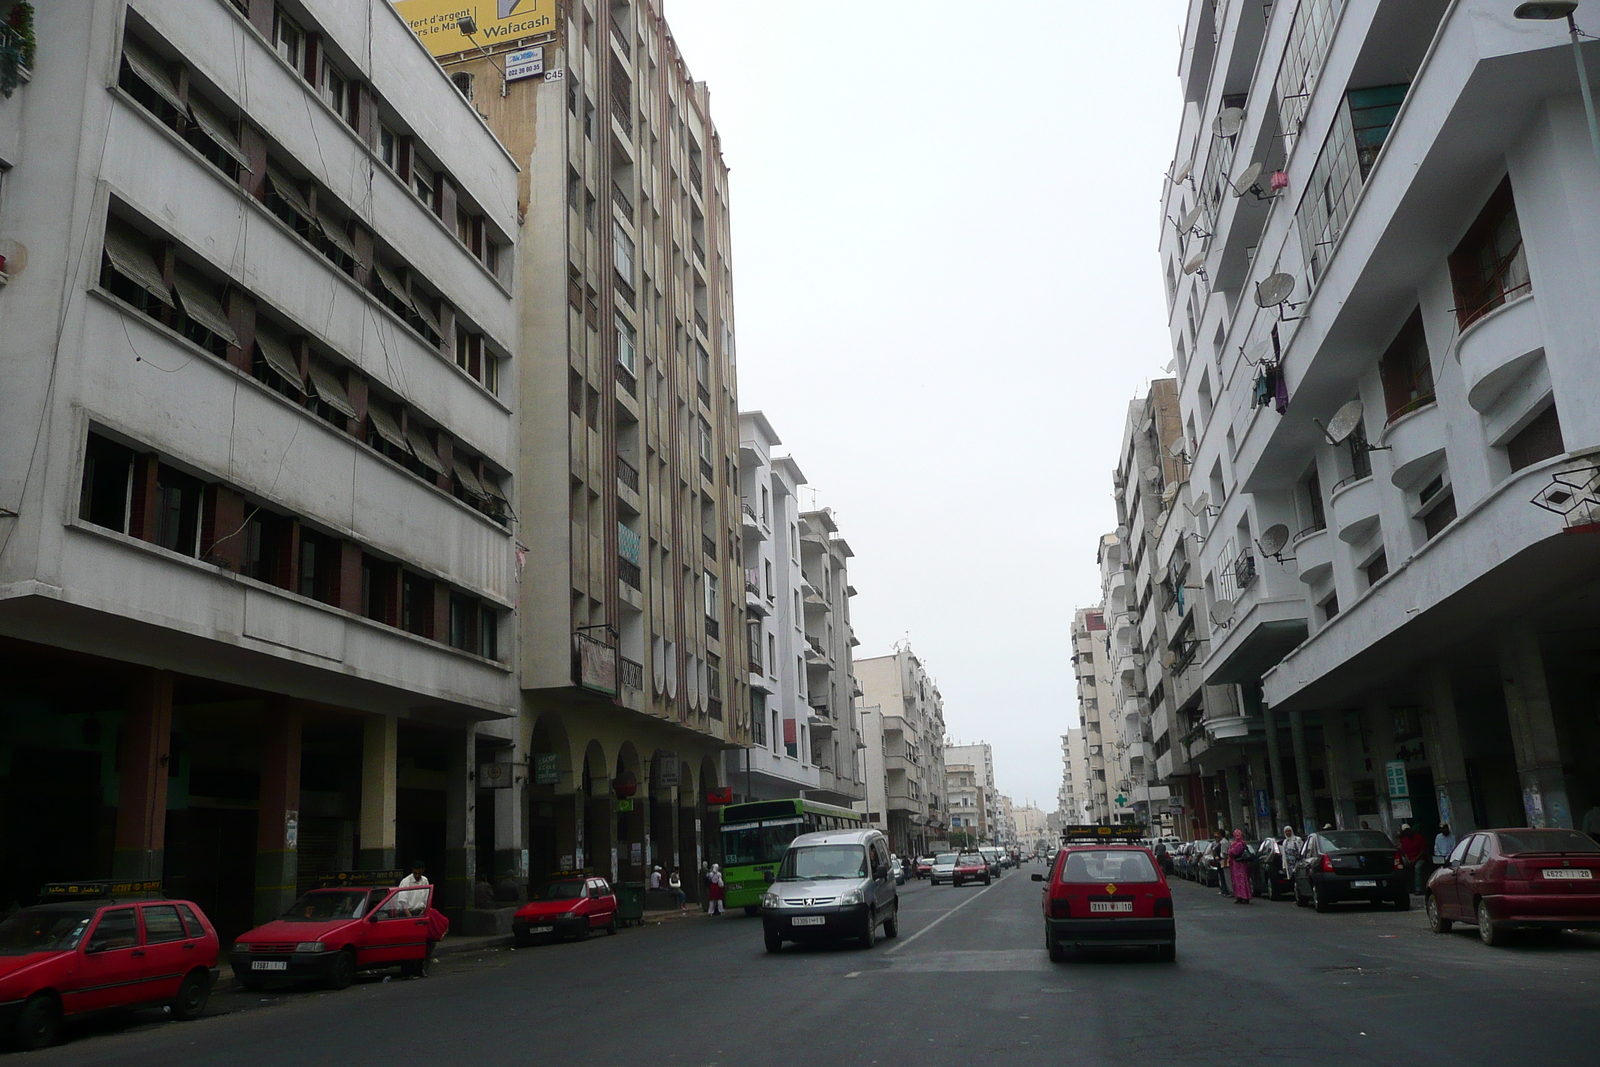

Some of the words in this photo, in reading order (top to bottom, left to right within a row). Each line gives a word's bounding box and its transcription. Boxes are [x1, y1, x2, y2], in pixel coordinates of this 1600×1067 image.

[408, 18, 428, 29] fert
[430, 8, 471, 24] d'argent
[430, 26, 439, 34] le
[441, 22, 460, 32] Mar
[483, 15, 550, 39] Wafacash
[545, 70, 564, 80] C45
[1124, 903, 1132, 911] 10
